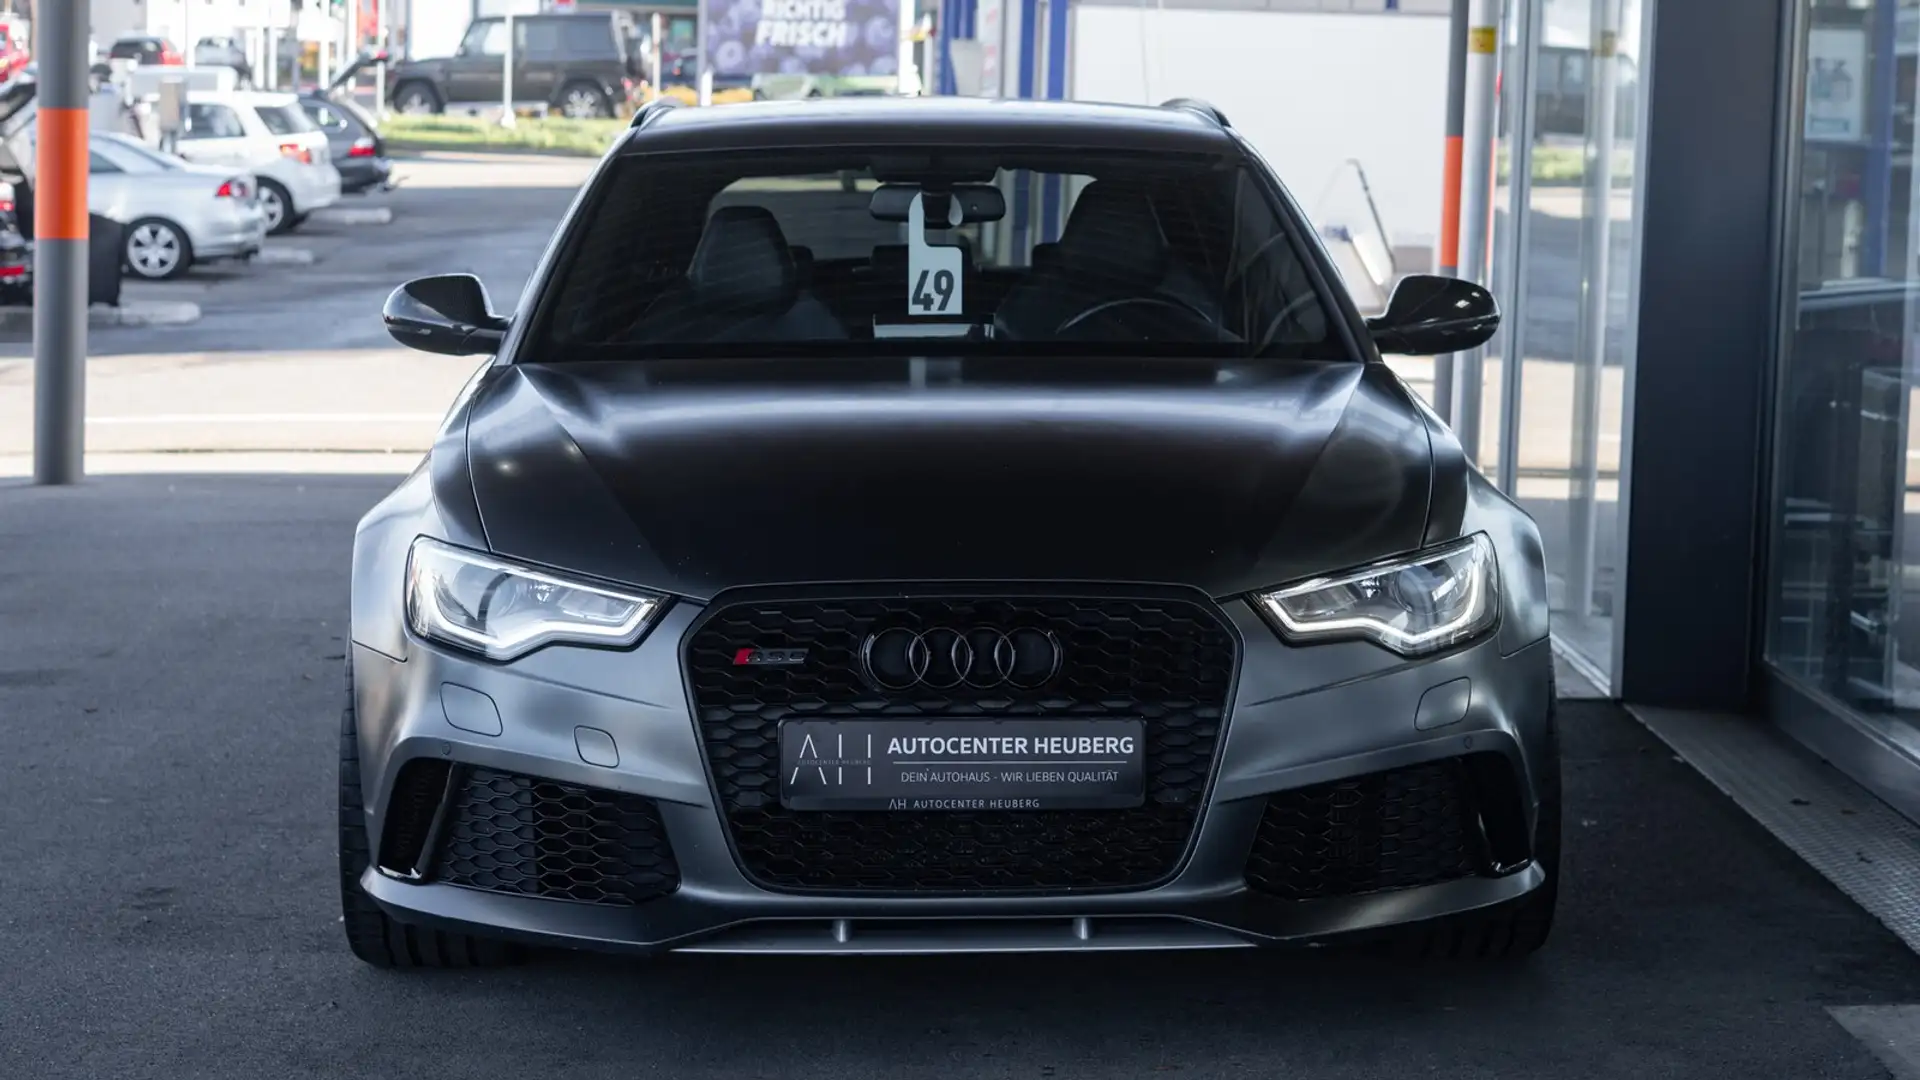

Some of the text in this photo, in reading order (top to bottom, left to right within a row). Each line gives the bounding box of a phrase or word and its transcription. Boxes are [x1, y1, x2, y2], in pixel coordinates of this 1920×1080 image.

[754, 20, 848, 47] FRISCH
[912, 269, 954, 311] 49
[887, 736, 1134, 755] AUTOCENTER HEUBERG
[901, 771, 928, 783] DEIN
[929, 771, 991, 783] AUTOHAUS
[1000, 771, 1023, 782] WIR
[1026, 771, 1065, 782] LIEBEN
[1067, 768, 1119, 784] QUALITÄT
[913, 799, 985, 809] AUTOCENTER
[989, 799, 1040, 809] HEUBERG
